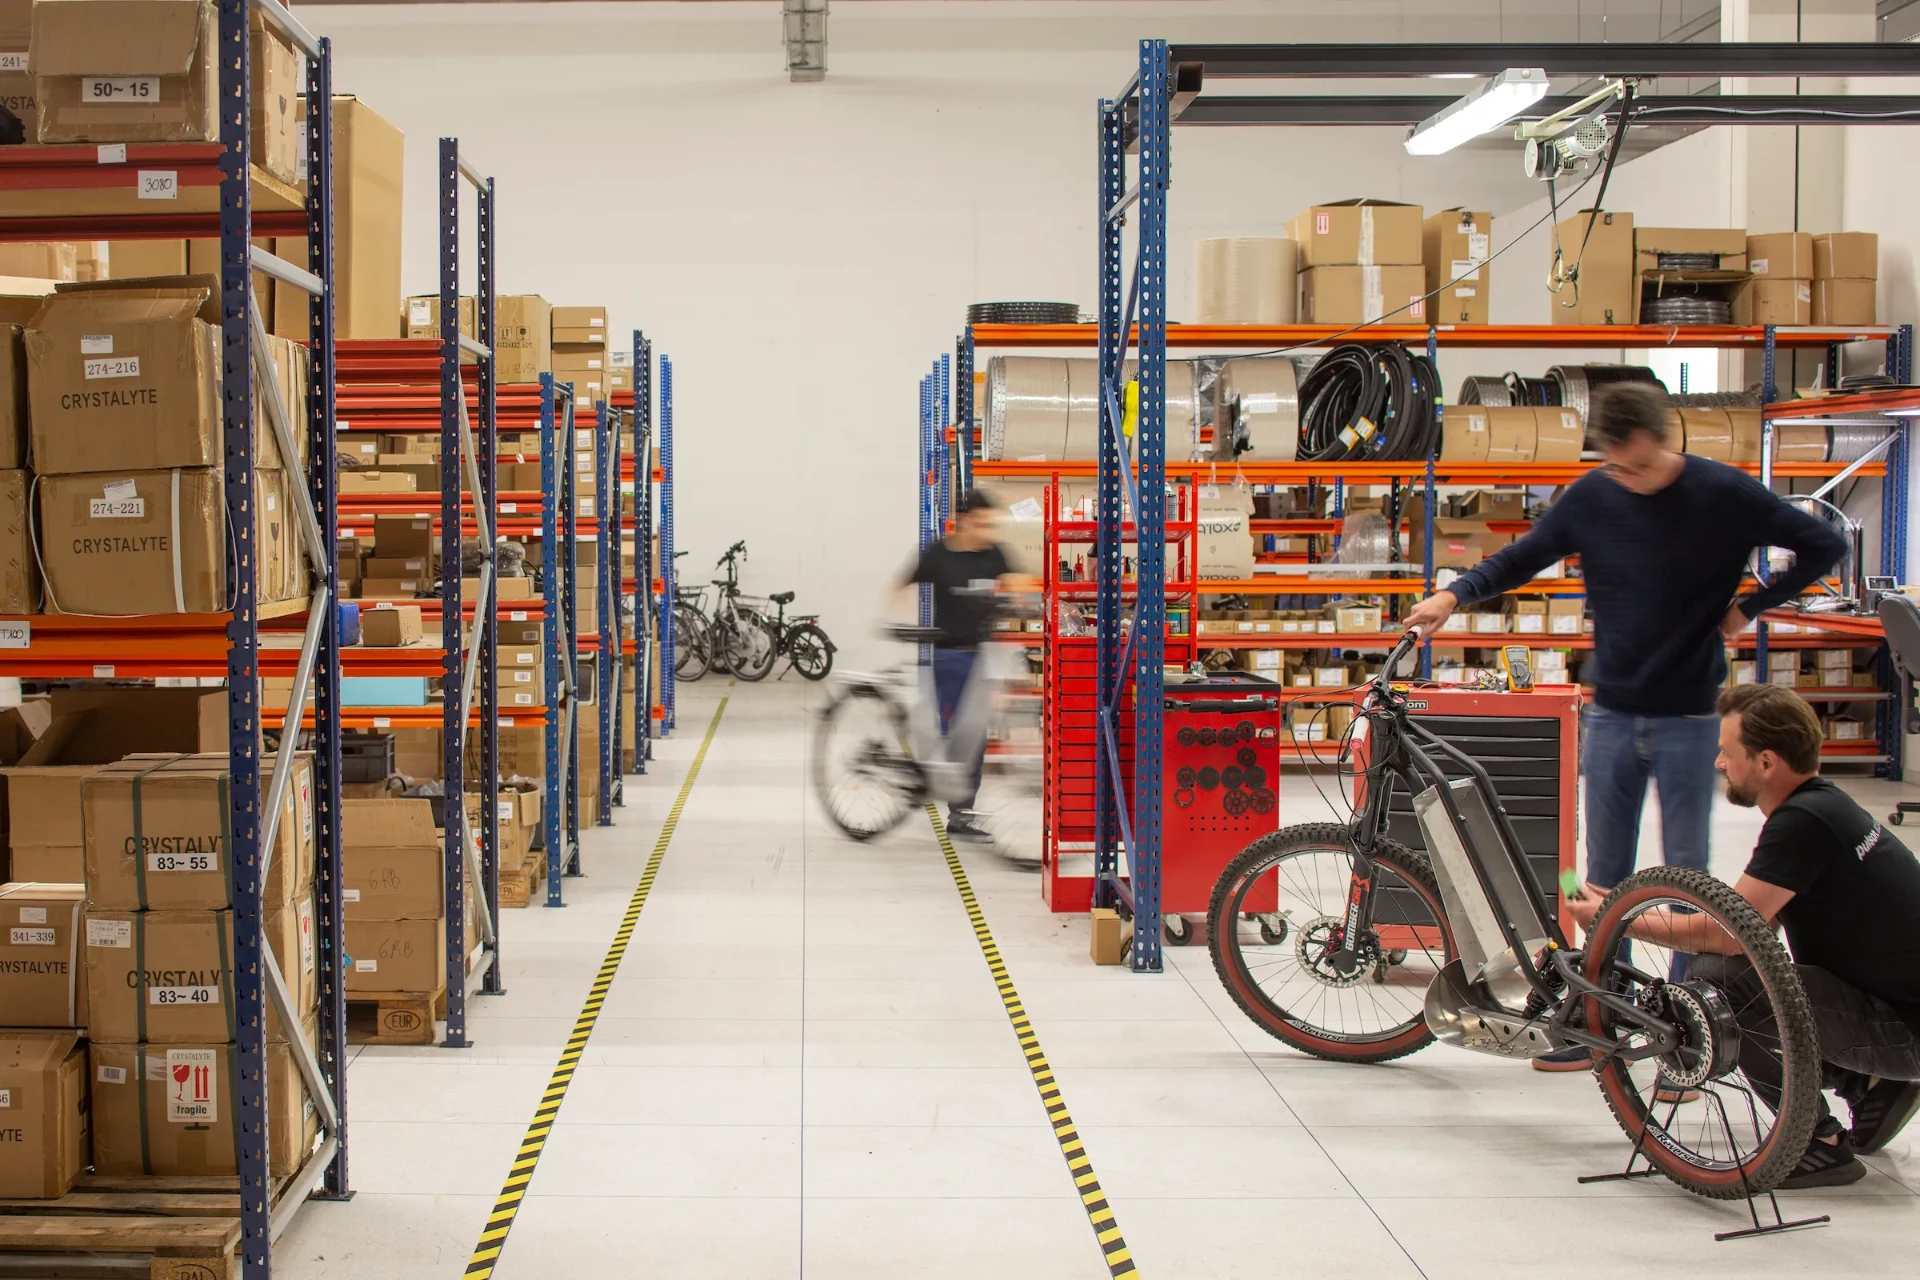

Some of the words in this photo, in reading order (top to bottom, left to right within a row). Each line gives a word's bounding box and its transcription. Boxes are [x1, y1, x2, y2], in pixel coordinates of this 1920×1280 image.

[2, 57, 28, 67] 241-
[93, 82, 124, 97] 50~
[130, 82, 149, 97] 15
[145, 178, 173, 193] 3080
[88, 361, 137, 376] 274-216
[61, 388, 158, 410] CRYSTALYTE
[93, 502, 141, 515] 274-221
[73, 536, 168, 555] CRYSTALYTE
[125, 836, 231, 855] CRYSTALY
[157, 856, 185, 870] 83~
[189, 856, 208, 870] 55
[12, 931, 54, 942] 341-339
[0, 960, 68, 974] RYSTALYTE
[126, 969, 233, 989] CRYSTALY
[159, 990, 186, 1003] 83~
[191, 989, 209, 1002] 40
[391, 1014, 413, 1028] EUR
[1300, 1024, 1345, 1041] Reverse
[172, 1052, 212, 1061] CRYSTALYTE
[176, 1105, 208, 1116] fragile
[1656, 1132, 1696, 1162] Reverse
